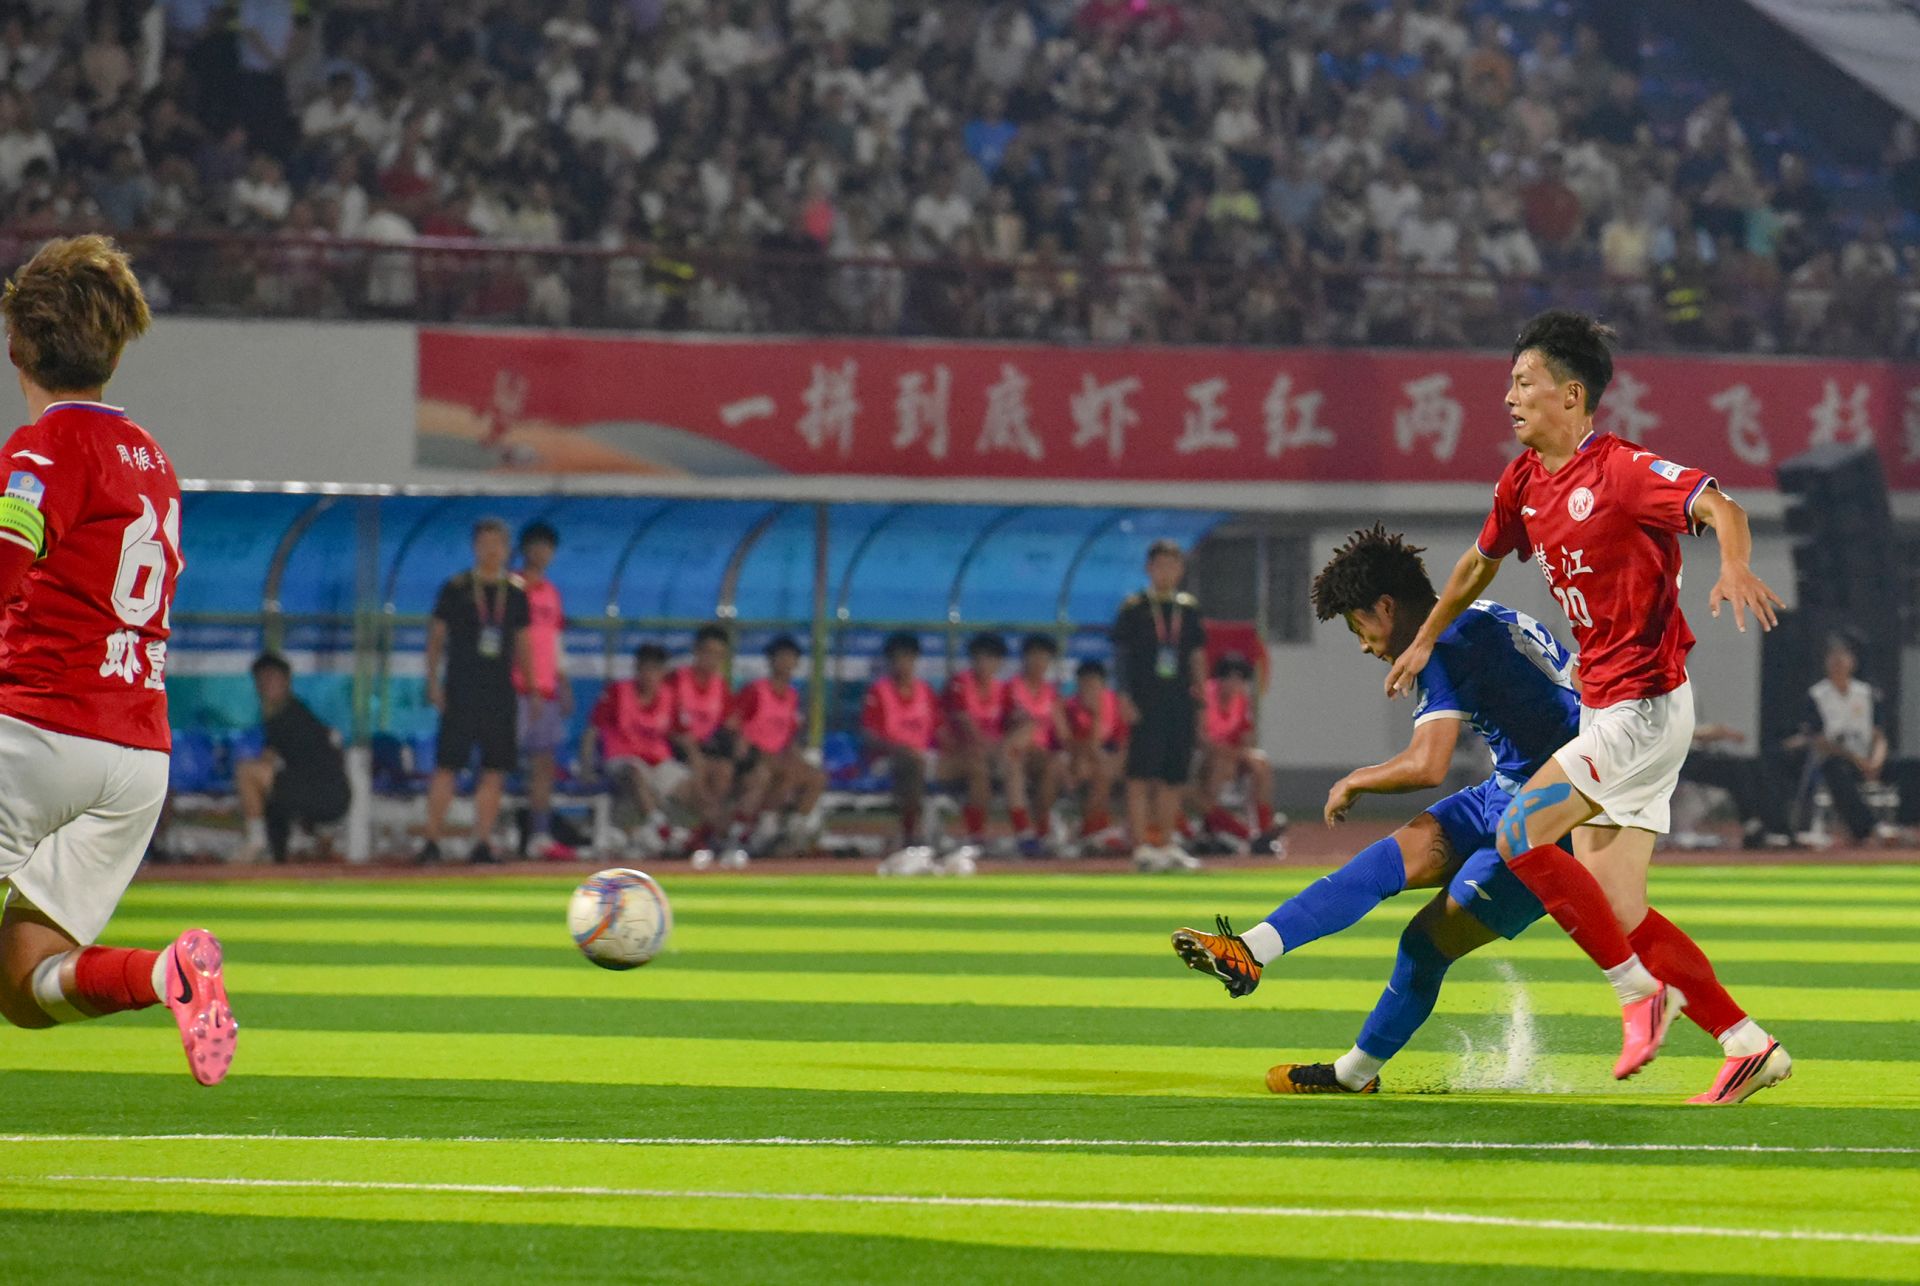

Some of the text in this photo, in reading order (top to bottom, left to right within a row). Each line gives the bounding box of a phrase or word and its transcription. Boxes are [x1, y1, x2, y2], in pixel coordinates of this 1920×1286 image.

[719, 359, 1338, 461] 一拼到底虾正红
[1553, 586, 1594, 629] 20
